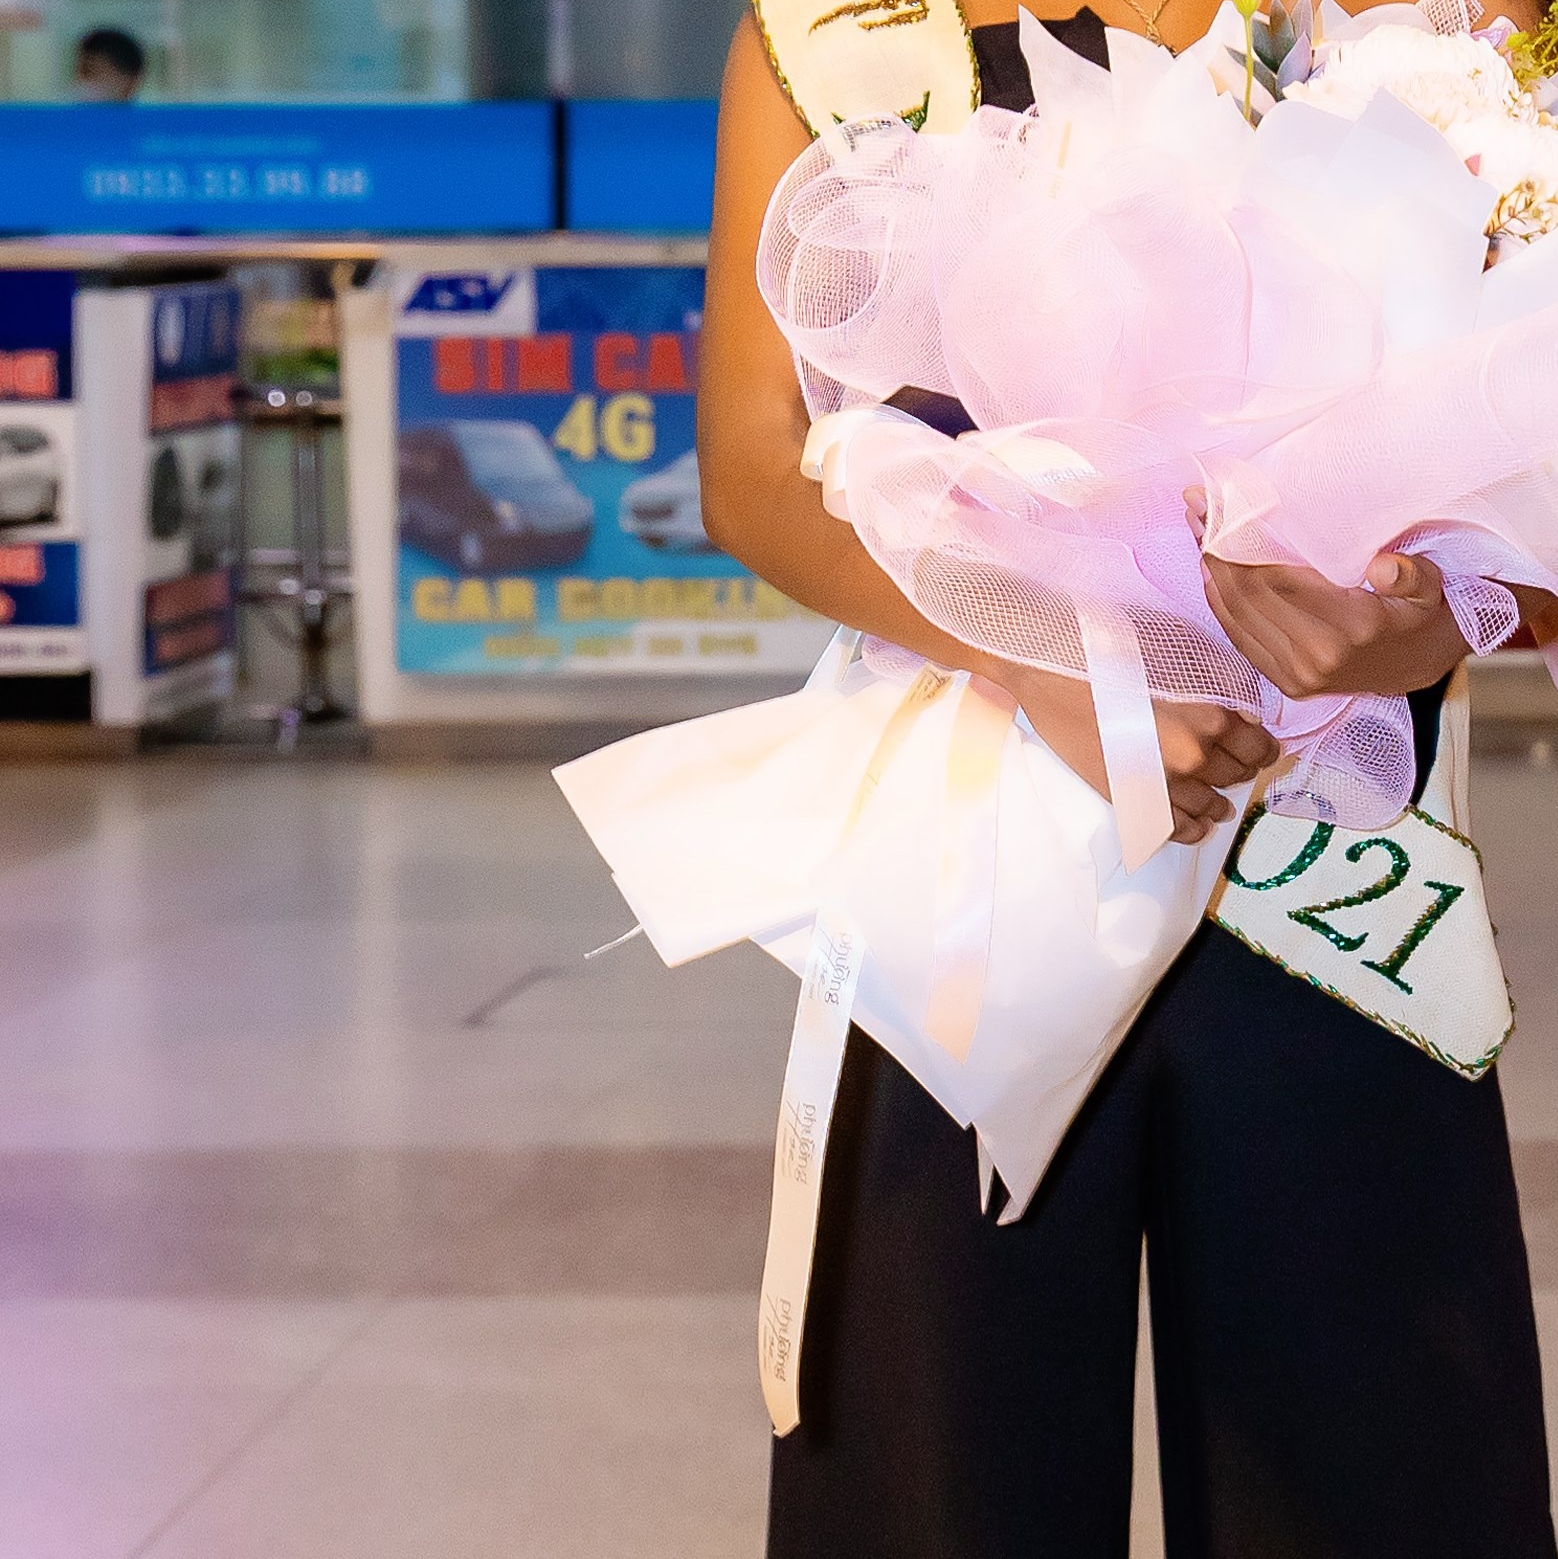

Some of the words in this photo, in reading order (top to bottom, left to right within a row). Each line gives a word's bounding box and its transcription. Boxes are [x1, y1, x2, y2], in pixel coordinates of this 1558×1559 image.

[432, 335, 573, 392] SIM
[594, 332, 701, 392] CA
[552, 392, 657, 464] 4G
